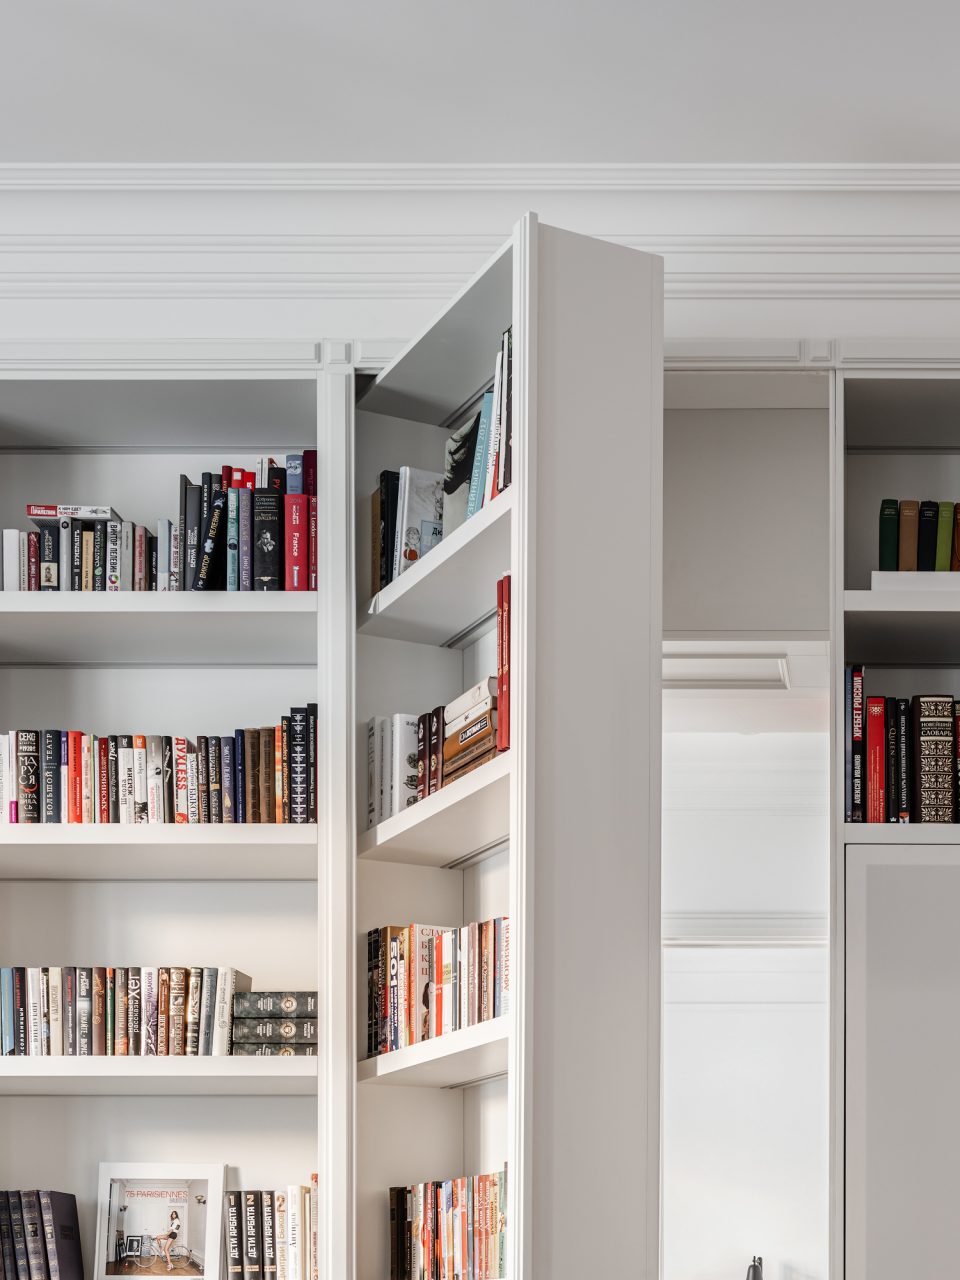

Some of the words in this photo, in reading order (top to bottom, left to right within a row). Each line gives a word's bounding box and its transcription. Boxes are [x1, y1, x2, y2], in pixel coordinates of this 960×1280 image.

[474, 445, 483, 466] ГИД
[479, 417, 487, 440] 2012
[110, 524, 118, 546] ВИКТОР
[199, 555, 209, 579] ВИКТОР
[208, 509, 221, 538] ПЕЛЕВИН
[110, 547, 118, 573] ПЕЛЕВИН
[853, 677, 862, 708] РОССИИ
[853, 710, 862, 737] ХРЕБЕТ
[109, 742, 118, 761] Грех
[175, 737, 187, 790] ДУХLESS
[853, 755, 861, 777] ИВАНОВ
[19, 775, 36, 785] СЯ
[44, 771, 53, 816] БОЛЬШОЙ
[853, 779, 861, 804] АЛЕКСЕЙ
[188, 788, 197, 818] БЫКОВ
[390, 942, 398, 987] 501
[136, 1190, 188, 1198] PARISIENNES
[229, 1206, 237, 1237] АРБАТА
[246, 1206, 256, 1236] АРБАТА
[264, 1206, 272, 1237] АРБАТА
[276, 1212, 285, 1240] Быков
[230, 1237, 239, 1258] ДЕТИ
[247, 1237, 257, 1258] ДЕТИ
[265, 1237, 274, 1258] ДЕТИ
